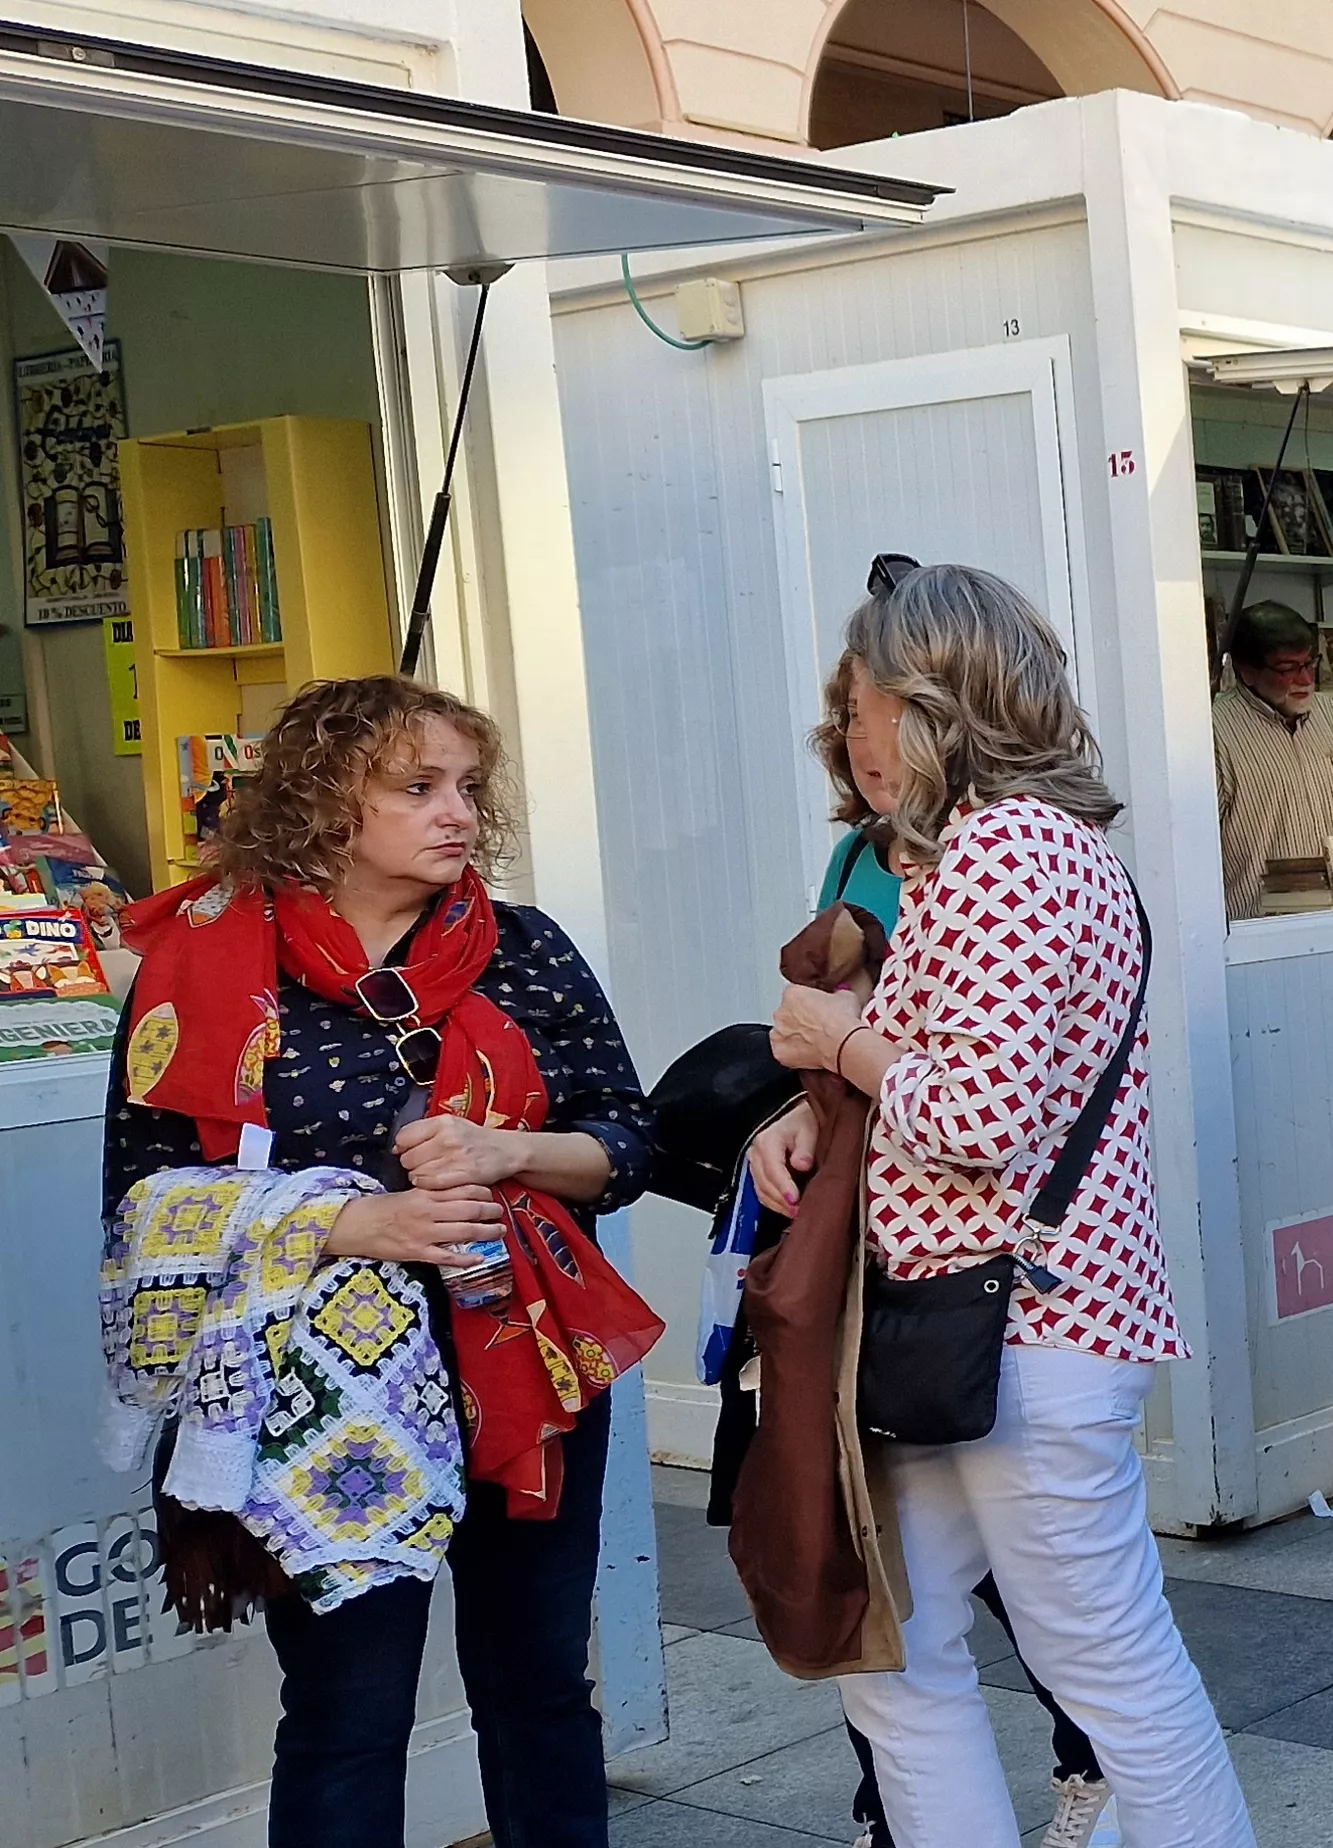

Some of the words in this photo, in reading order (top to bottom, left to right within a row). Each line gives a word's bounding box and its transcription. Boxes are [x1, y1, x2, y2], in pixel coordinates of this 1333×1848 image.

[1003, 319, 1019, 337] 13
[65, 601, 127, 617] DESCUENTO
[25, 920, 77, 938] DINO
[0, 1018, 117, 1043] GENIERA
[60, 1593, 154, 1667] DE
